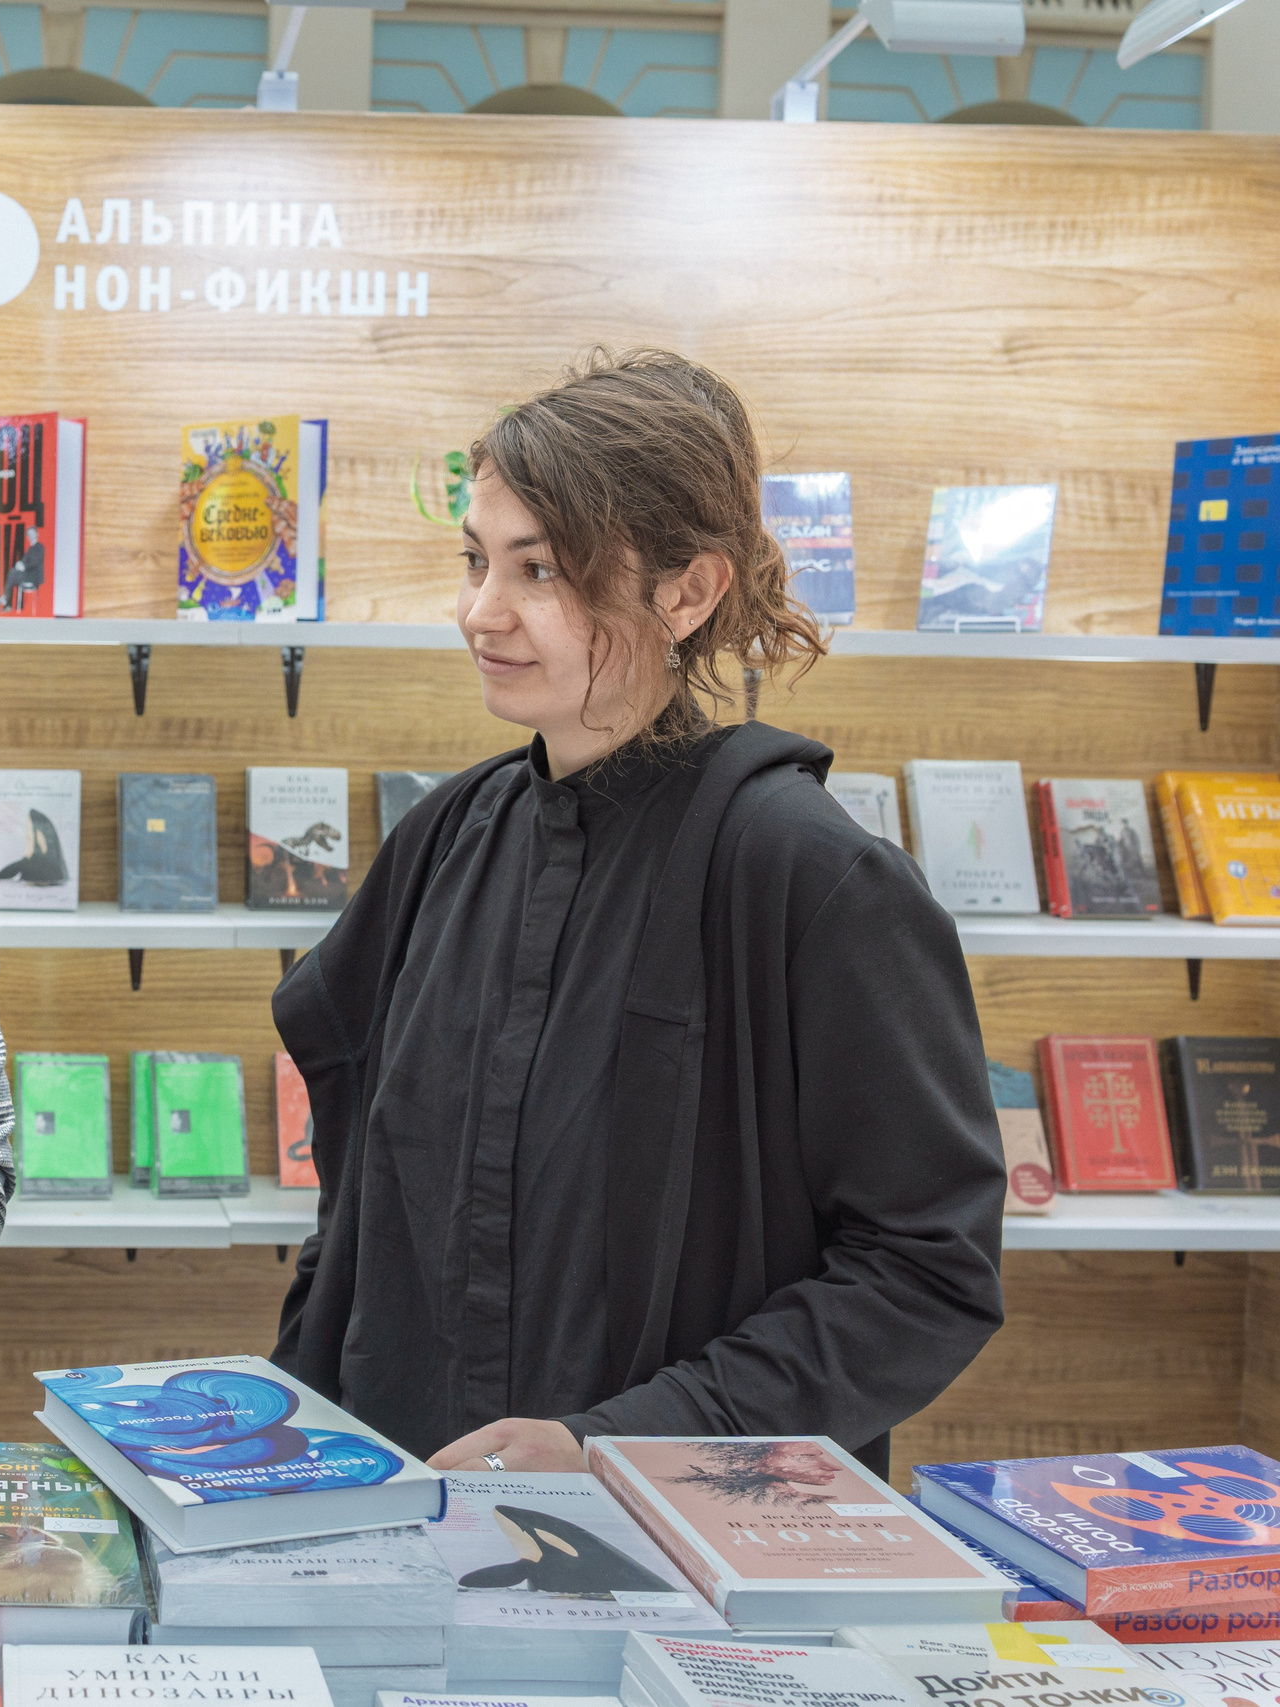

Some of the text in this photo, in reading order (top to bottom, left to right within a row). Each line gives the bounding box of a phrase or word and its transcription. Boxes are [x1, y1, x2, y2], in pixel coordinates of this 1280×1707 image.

[56, 197, 343, 248] АЛЬПИНА
[54, 264, 429, 317] НОН-ФИКШН
[119, 1409, 255, 1427] Андрей Россохин
[179, 1456, 377, 1482] бессознательного
[189, 1468, 349, 1491] Тайны нашего
[11, 1505, 82, 1513] ОЩУЩАЮТ
[726, 1521, 886, 1529] Нелюбимая
[999, 1497, 1109, 1557] Разбор
[1055, 1512, 1146, 1553] роли
[229, 1557, 328, 1565] ДЖОНАТАН
[1188, 1565, 1280, 1594] Разбор
[500, 1606, 662, 1619] ОЛЬГА ФИЛАТОВА
[1114, 1608, 1220, 1634] Разбор
[655, 1637, 809, 1658] Создание арки
[918, 1644, 990, 1658] Крис Смит
[919, 1639, 987, 1652] Бек Эванс
[125, 1653, 200, 1665] КАК
[663, 1646, 775, 1664] персонажа
[669, 1652, 757, 1669] Секреты
[65, 1669, 261, 1682] УМИРАЛИ
[677, 1662, 796, 1681] сценарного
[684, 1670, 809, 1690] мастерства:
[691, 1678, 784, 1697] единство
[914, 1670, 1065, 1698] Дойти
[36, 1687, 296, 1701] ДИНОЗАВРЫ
[699, 1687, 775, 1704] сюжета
